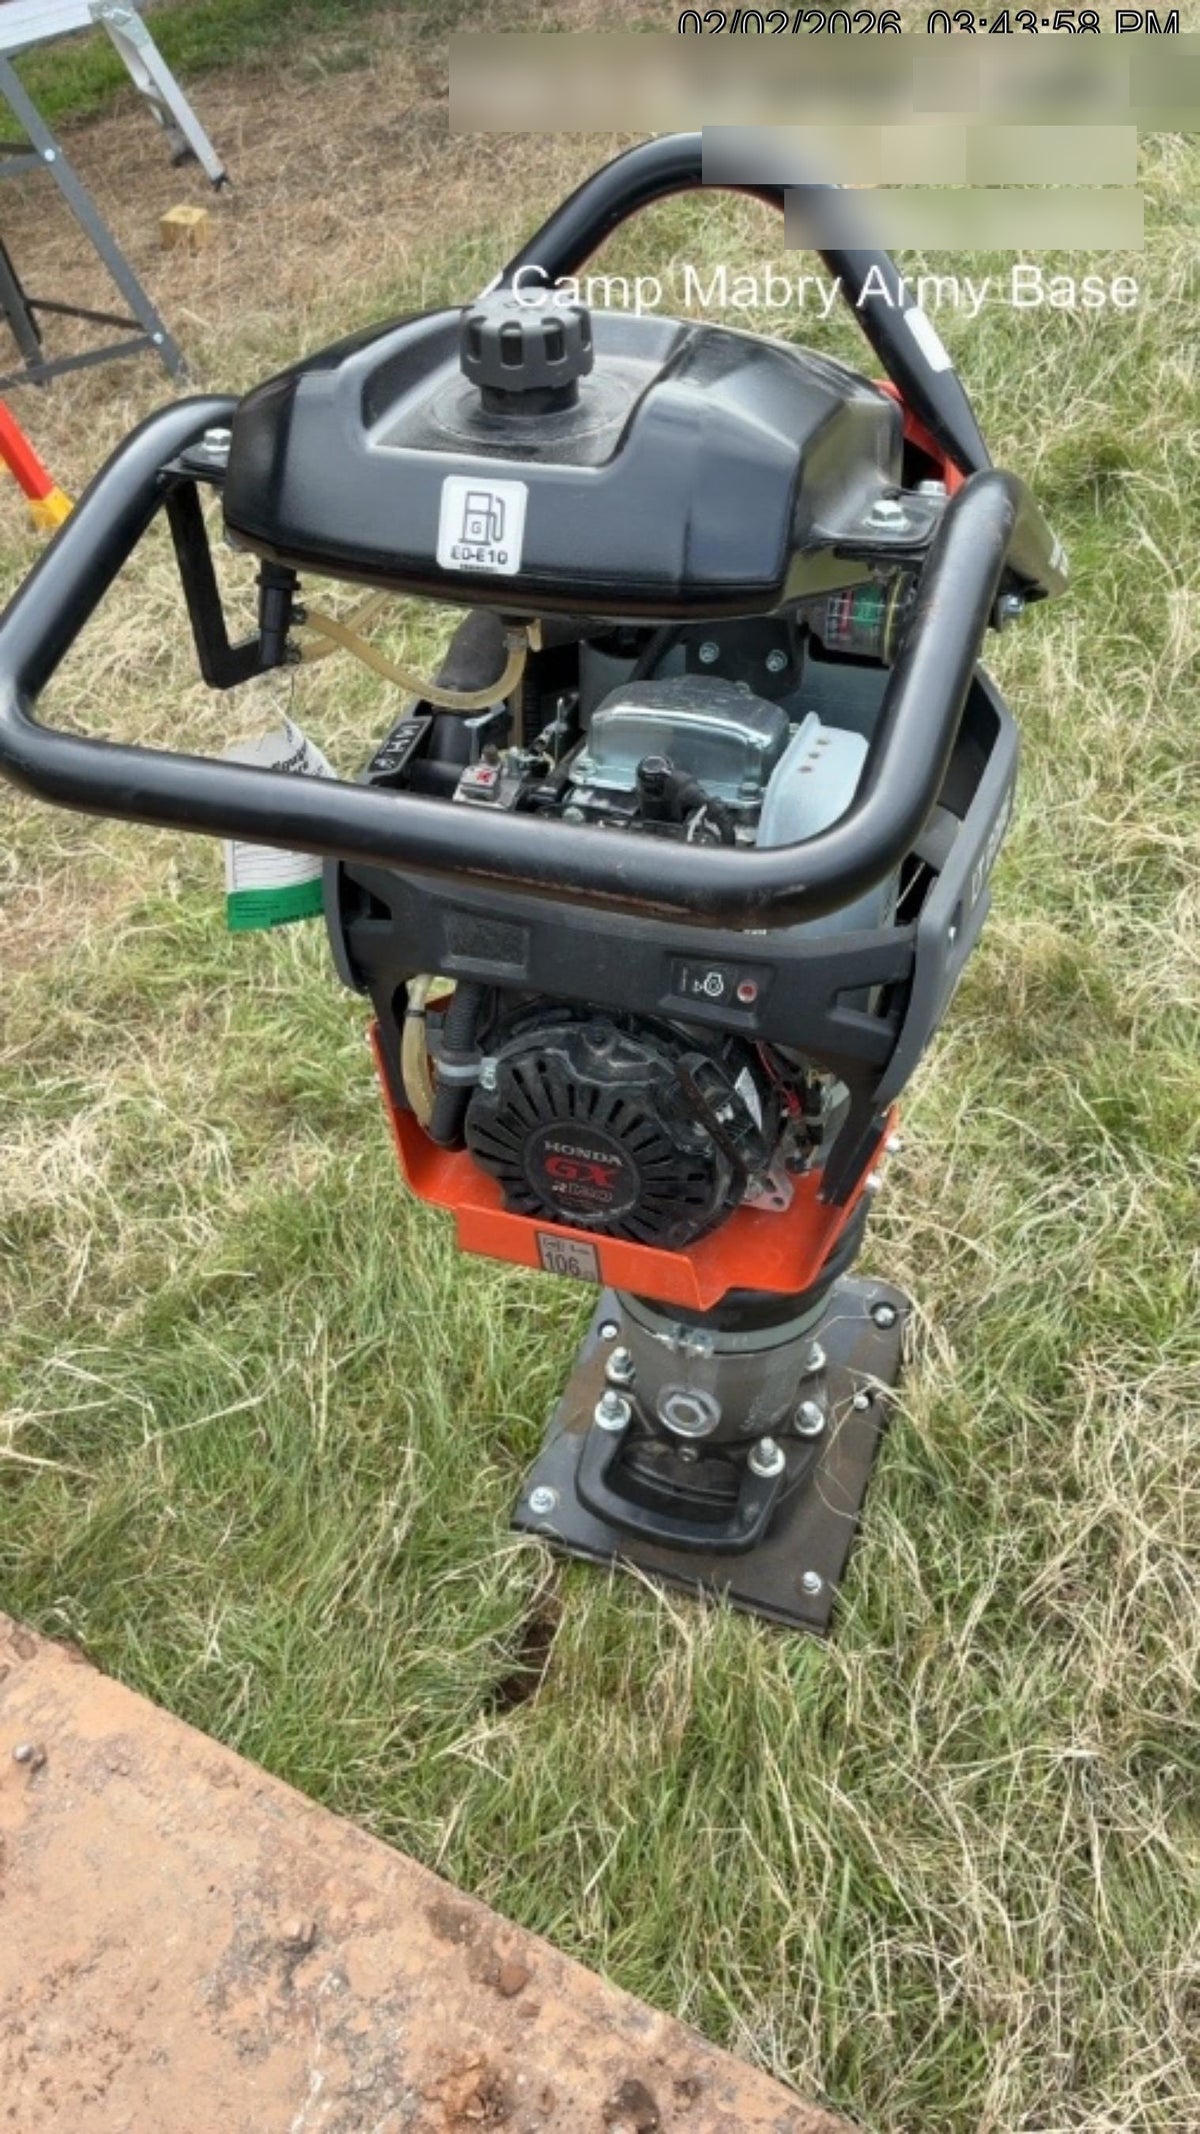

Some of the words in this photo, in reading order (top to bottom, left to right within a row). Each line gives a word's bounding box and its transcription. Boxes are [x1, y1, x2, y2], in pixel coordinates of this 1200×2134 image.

[544, 1140, 624, 1167] HONDA
[544, 1155, 619, 1188] GX
[545, 1250, 582, 1277] 106
